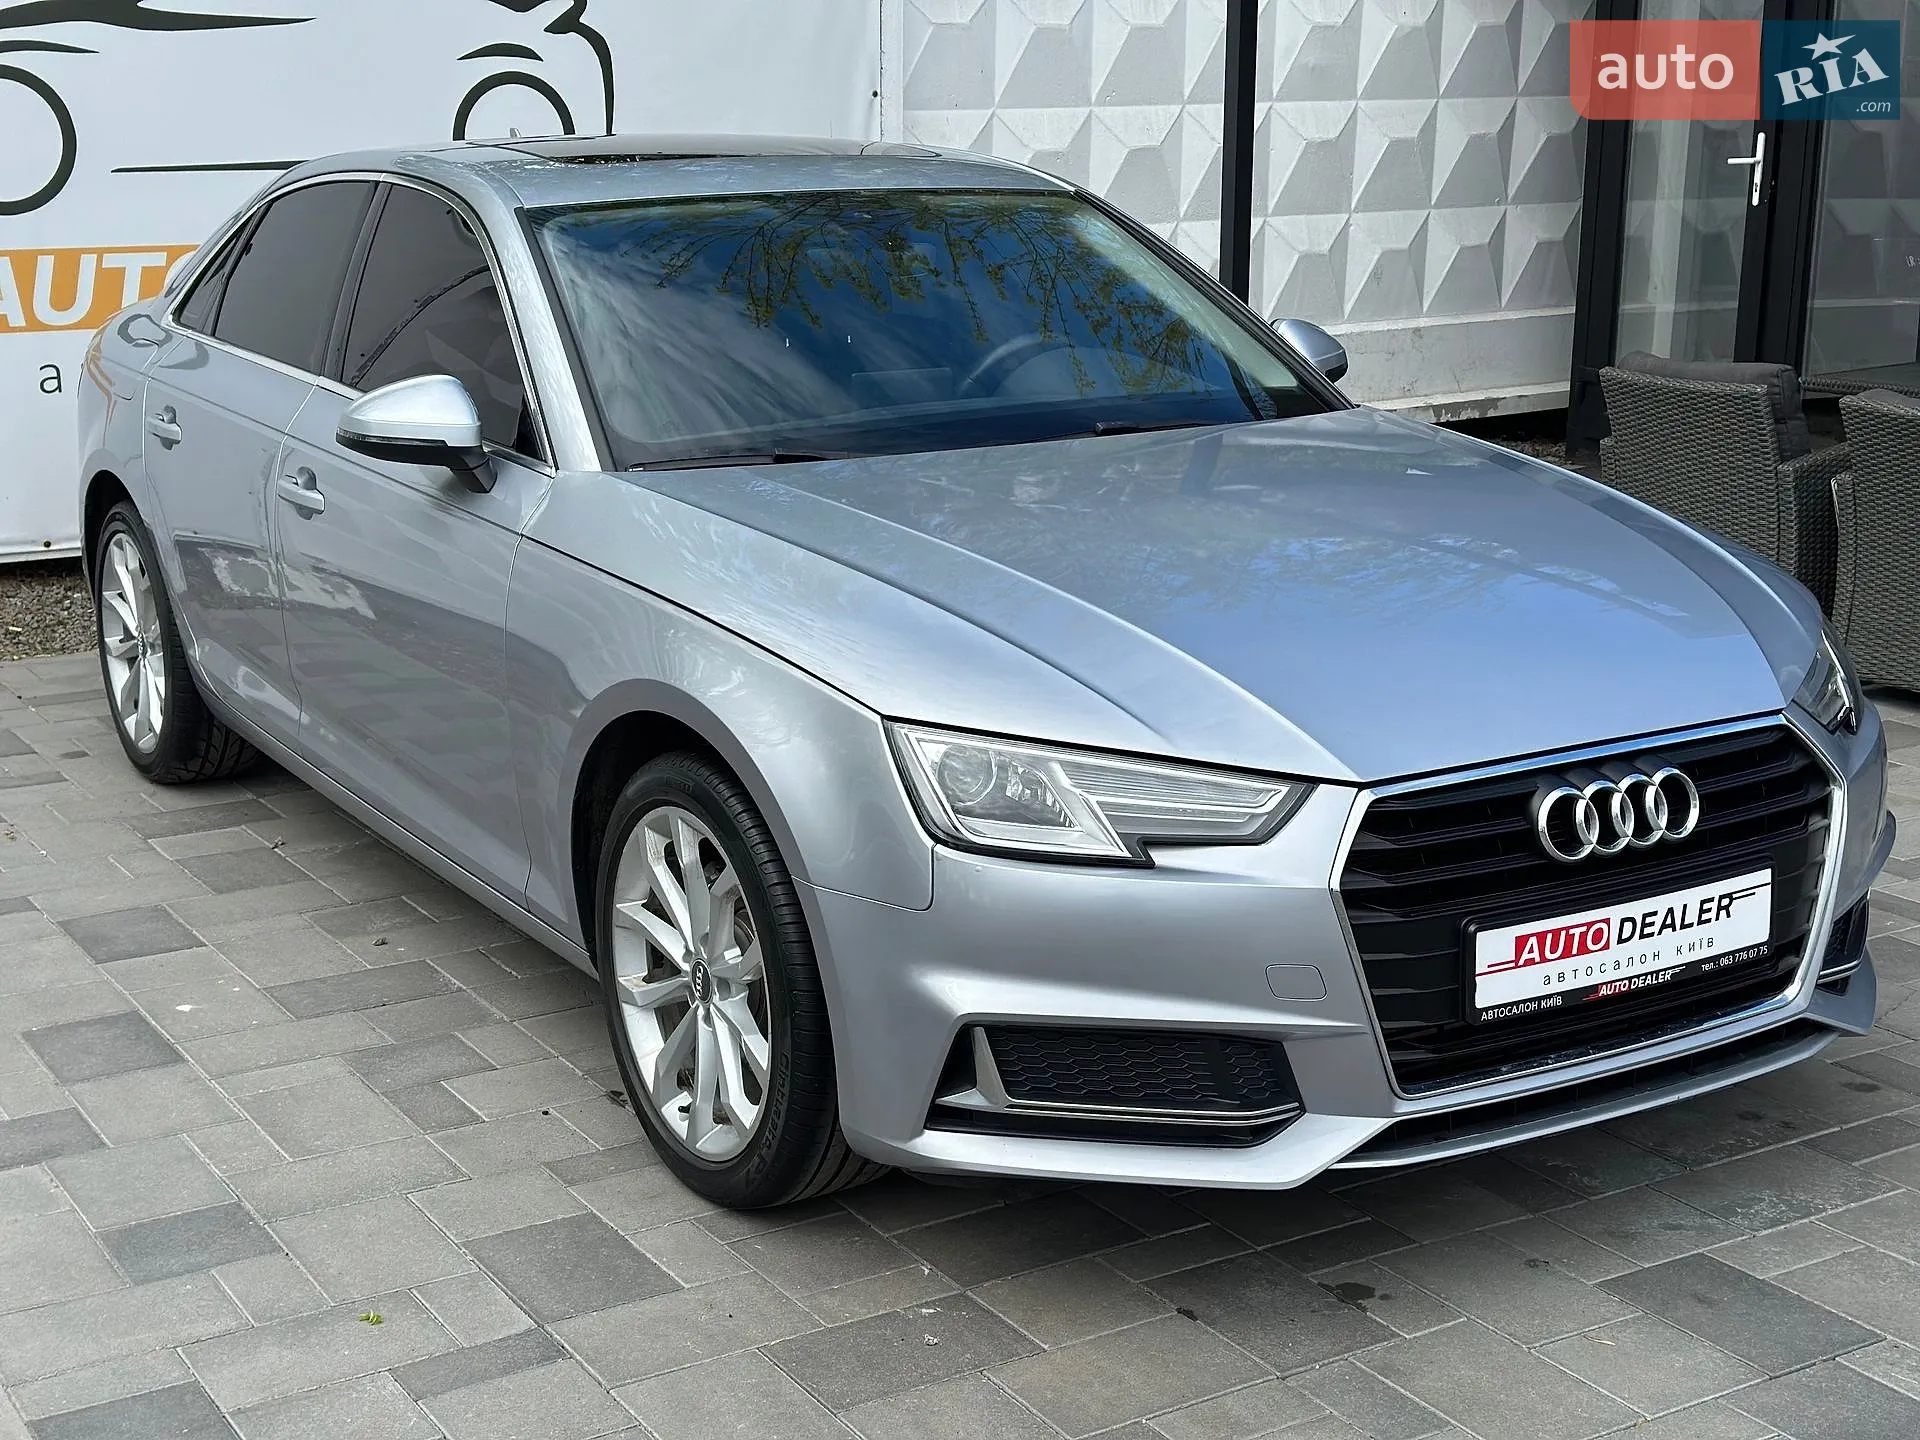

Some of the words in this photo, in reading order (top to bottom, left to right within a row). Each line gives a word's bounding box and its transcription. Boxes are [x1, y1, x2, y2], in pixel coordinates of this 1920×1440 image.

[0, 251, 196, 327] UT
[1518, 922, 1608, 966] AUTO
[1616, 893, 1734, 945] DEALER
[1543, 950, 1660, 986] автосалон
[1719, 955, 1733, 967] 063
[1734, 951, 1748, 962] 776
[1748, 948, 1758, 958] 07
[1759, 945, 1768, 956] 75
[1599, 979, 1629, 996] AUTO
[1630, 970, 1672, 989] DEALER
[1480, 1000, 1538, 1022] АВТОСАЛОН
[1540, 995, 1563, 1009] КИЇВ
